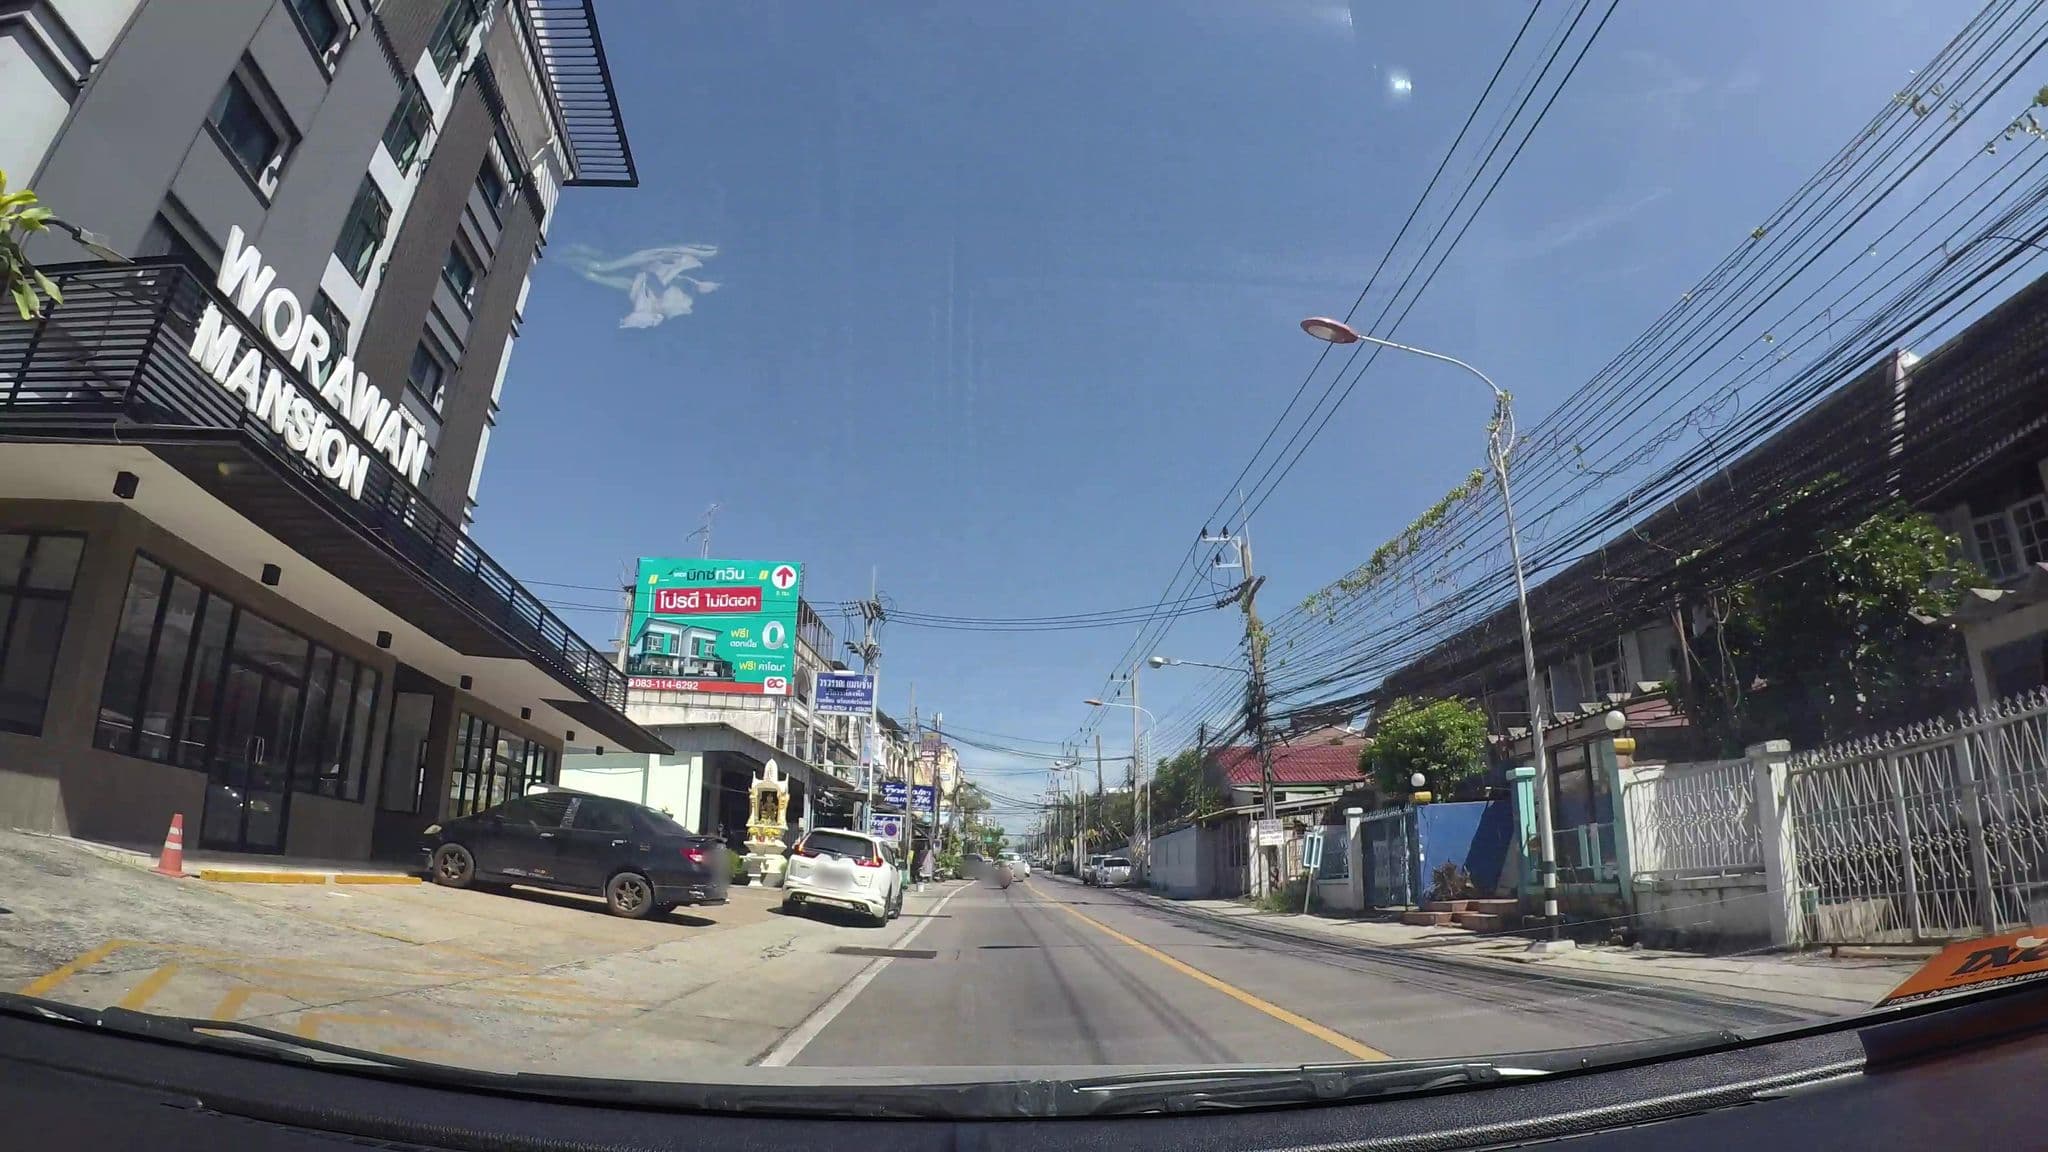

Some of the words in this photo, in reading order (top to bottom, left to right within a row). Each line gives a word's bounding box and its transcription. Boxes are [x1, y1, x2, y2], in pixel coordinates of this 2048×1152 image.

[188, 302, 370, 501] MANSION
[217, 224, 428, 488] WORAWAN
[660, 591, 699, 609] โปรดี
[705, 593, 757, 608] ไม่มีดอก
[635, 679, 698, 690] 083-114-6292
